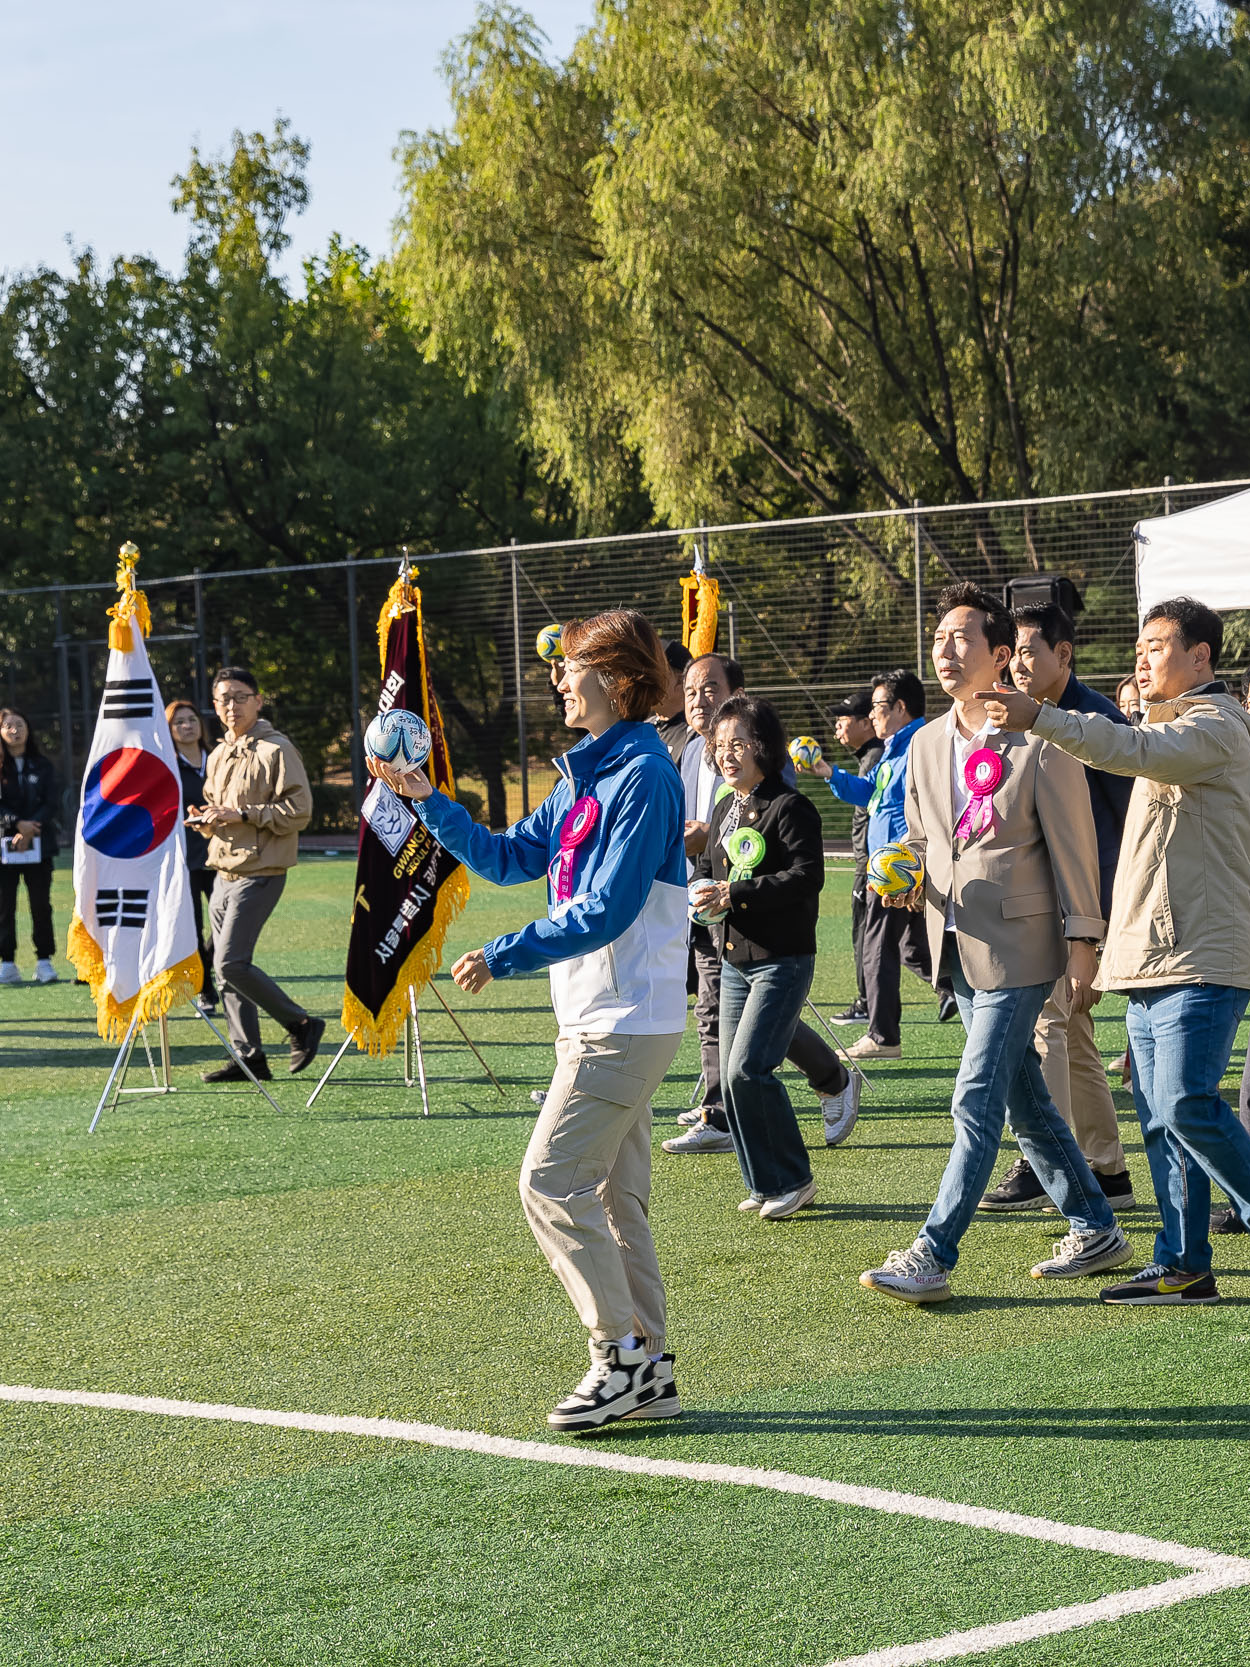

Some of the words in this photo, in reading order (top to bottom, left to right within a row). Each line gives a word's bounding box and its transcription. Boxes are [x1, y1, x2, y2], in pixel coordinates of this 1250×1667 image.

[378, 670, 405, 715] 대회
[392, 823, 429, 880] GWANGJI
[405, 848, 429, 876] SEOUL
[374, 883, 432, 965] 서울특별시
